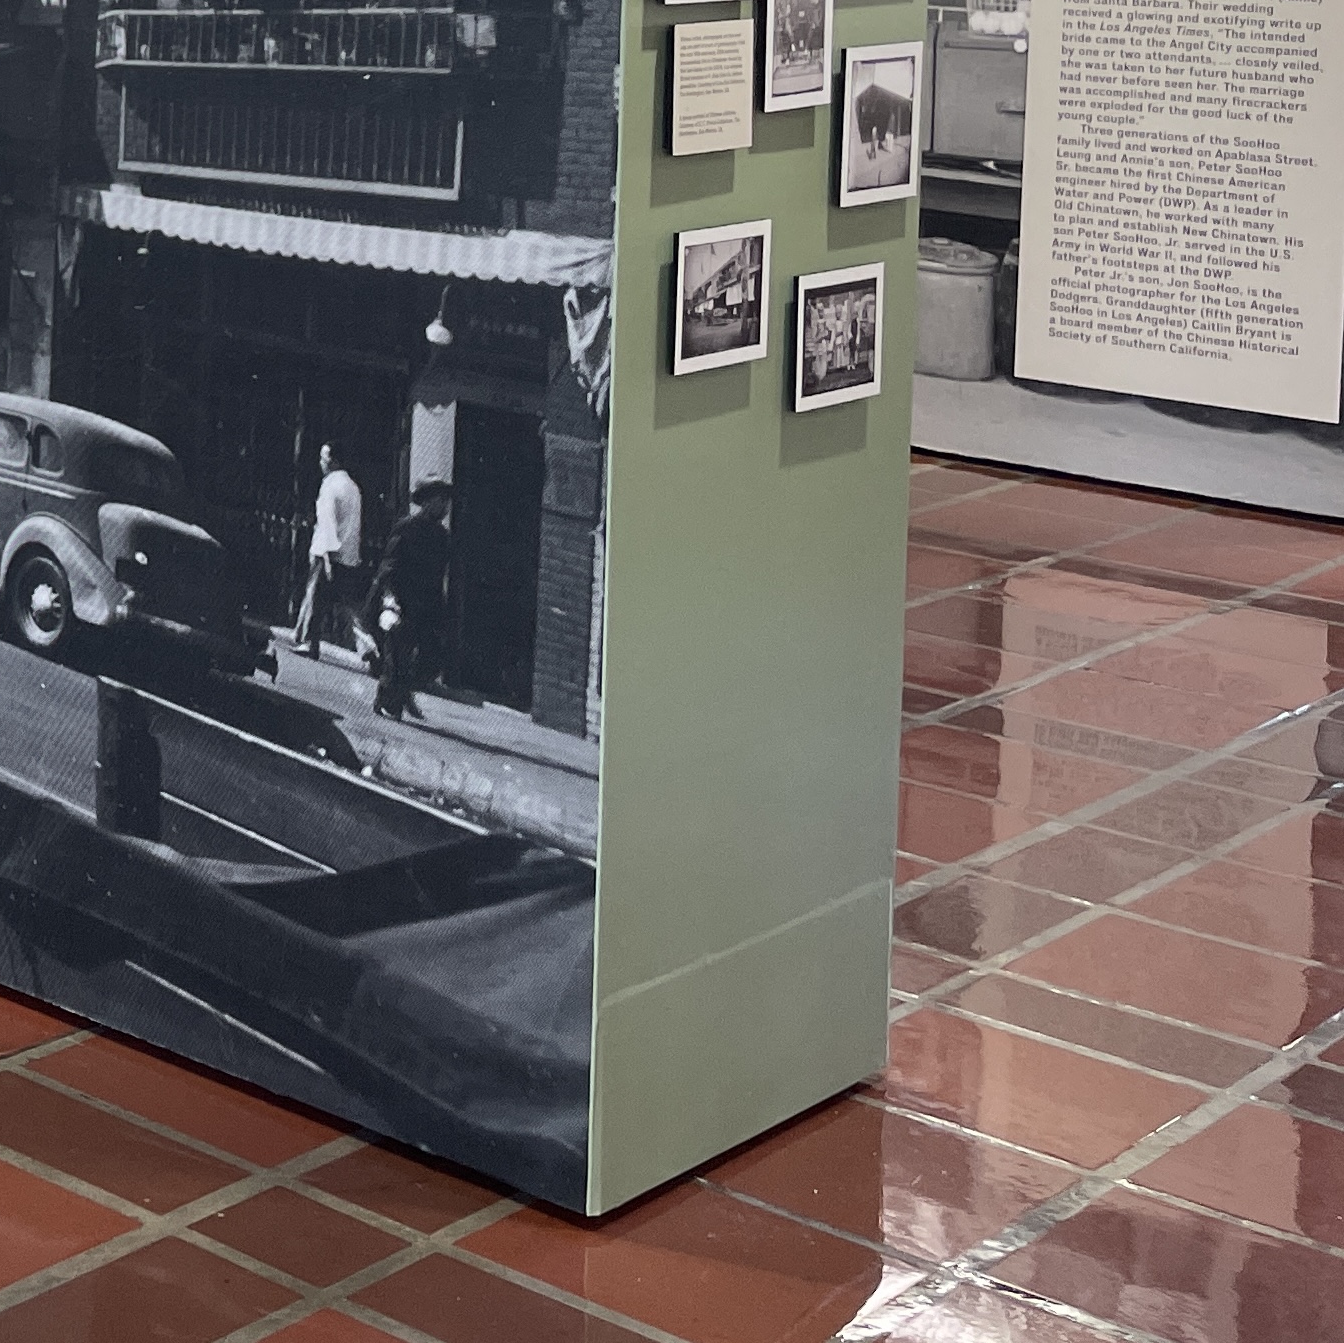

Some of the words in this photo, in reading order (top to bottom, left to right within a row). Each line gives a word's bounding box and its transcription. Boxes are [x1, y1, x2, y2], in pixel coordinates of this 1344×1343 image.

[1048, 327, 1091, 343] Society
[1095, 333, 1107, 344] of
[1111, 335, 1166, 351] Southern
[1169, 343, 1232, 360] California.
